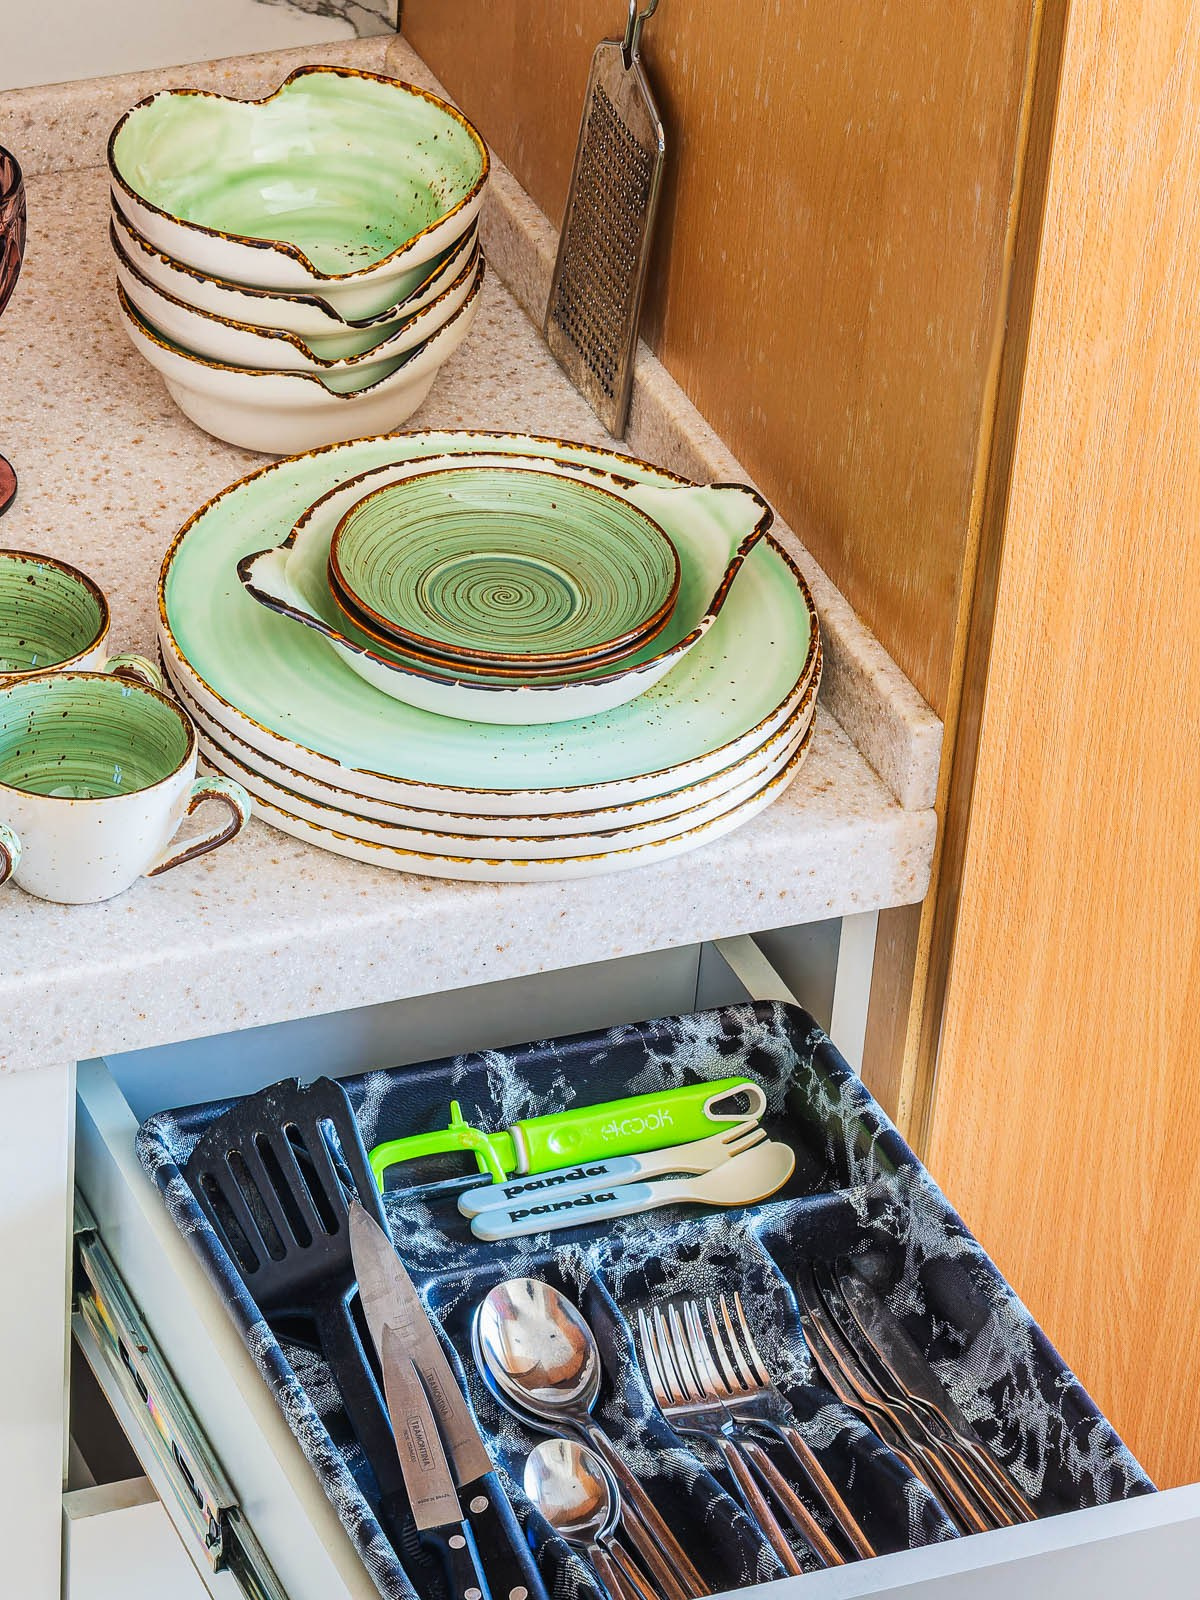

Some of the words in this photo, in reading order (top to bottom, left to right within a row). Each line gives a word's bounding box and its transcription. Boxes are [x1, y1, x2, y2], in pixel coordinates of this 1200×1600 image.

[501, 1165, 609, 1200] panda
[507, 1192, 618, 1223] panda
[426, 1372, 449, 1416] TRAMONTINA
[410, 1420, 431, 1467] TRAMONTINA
